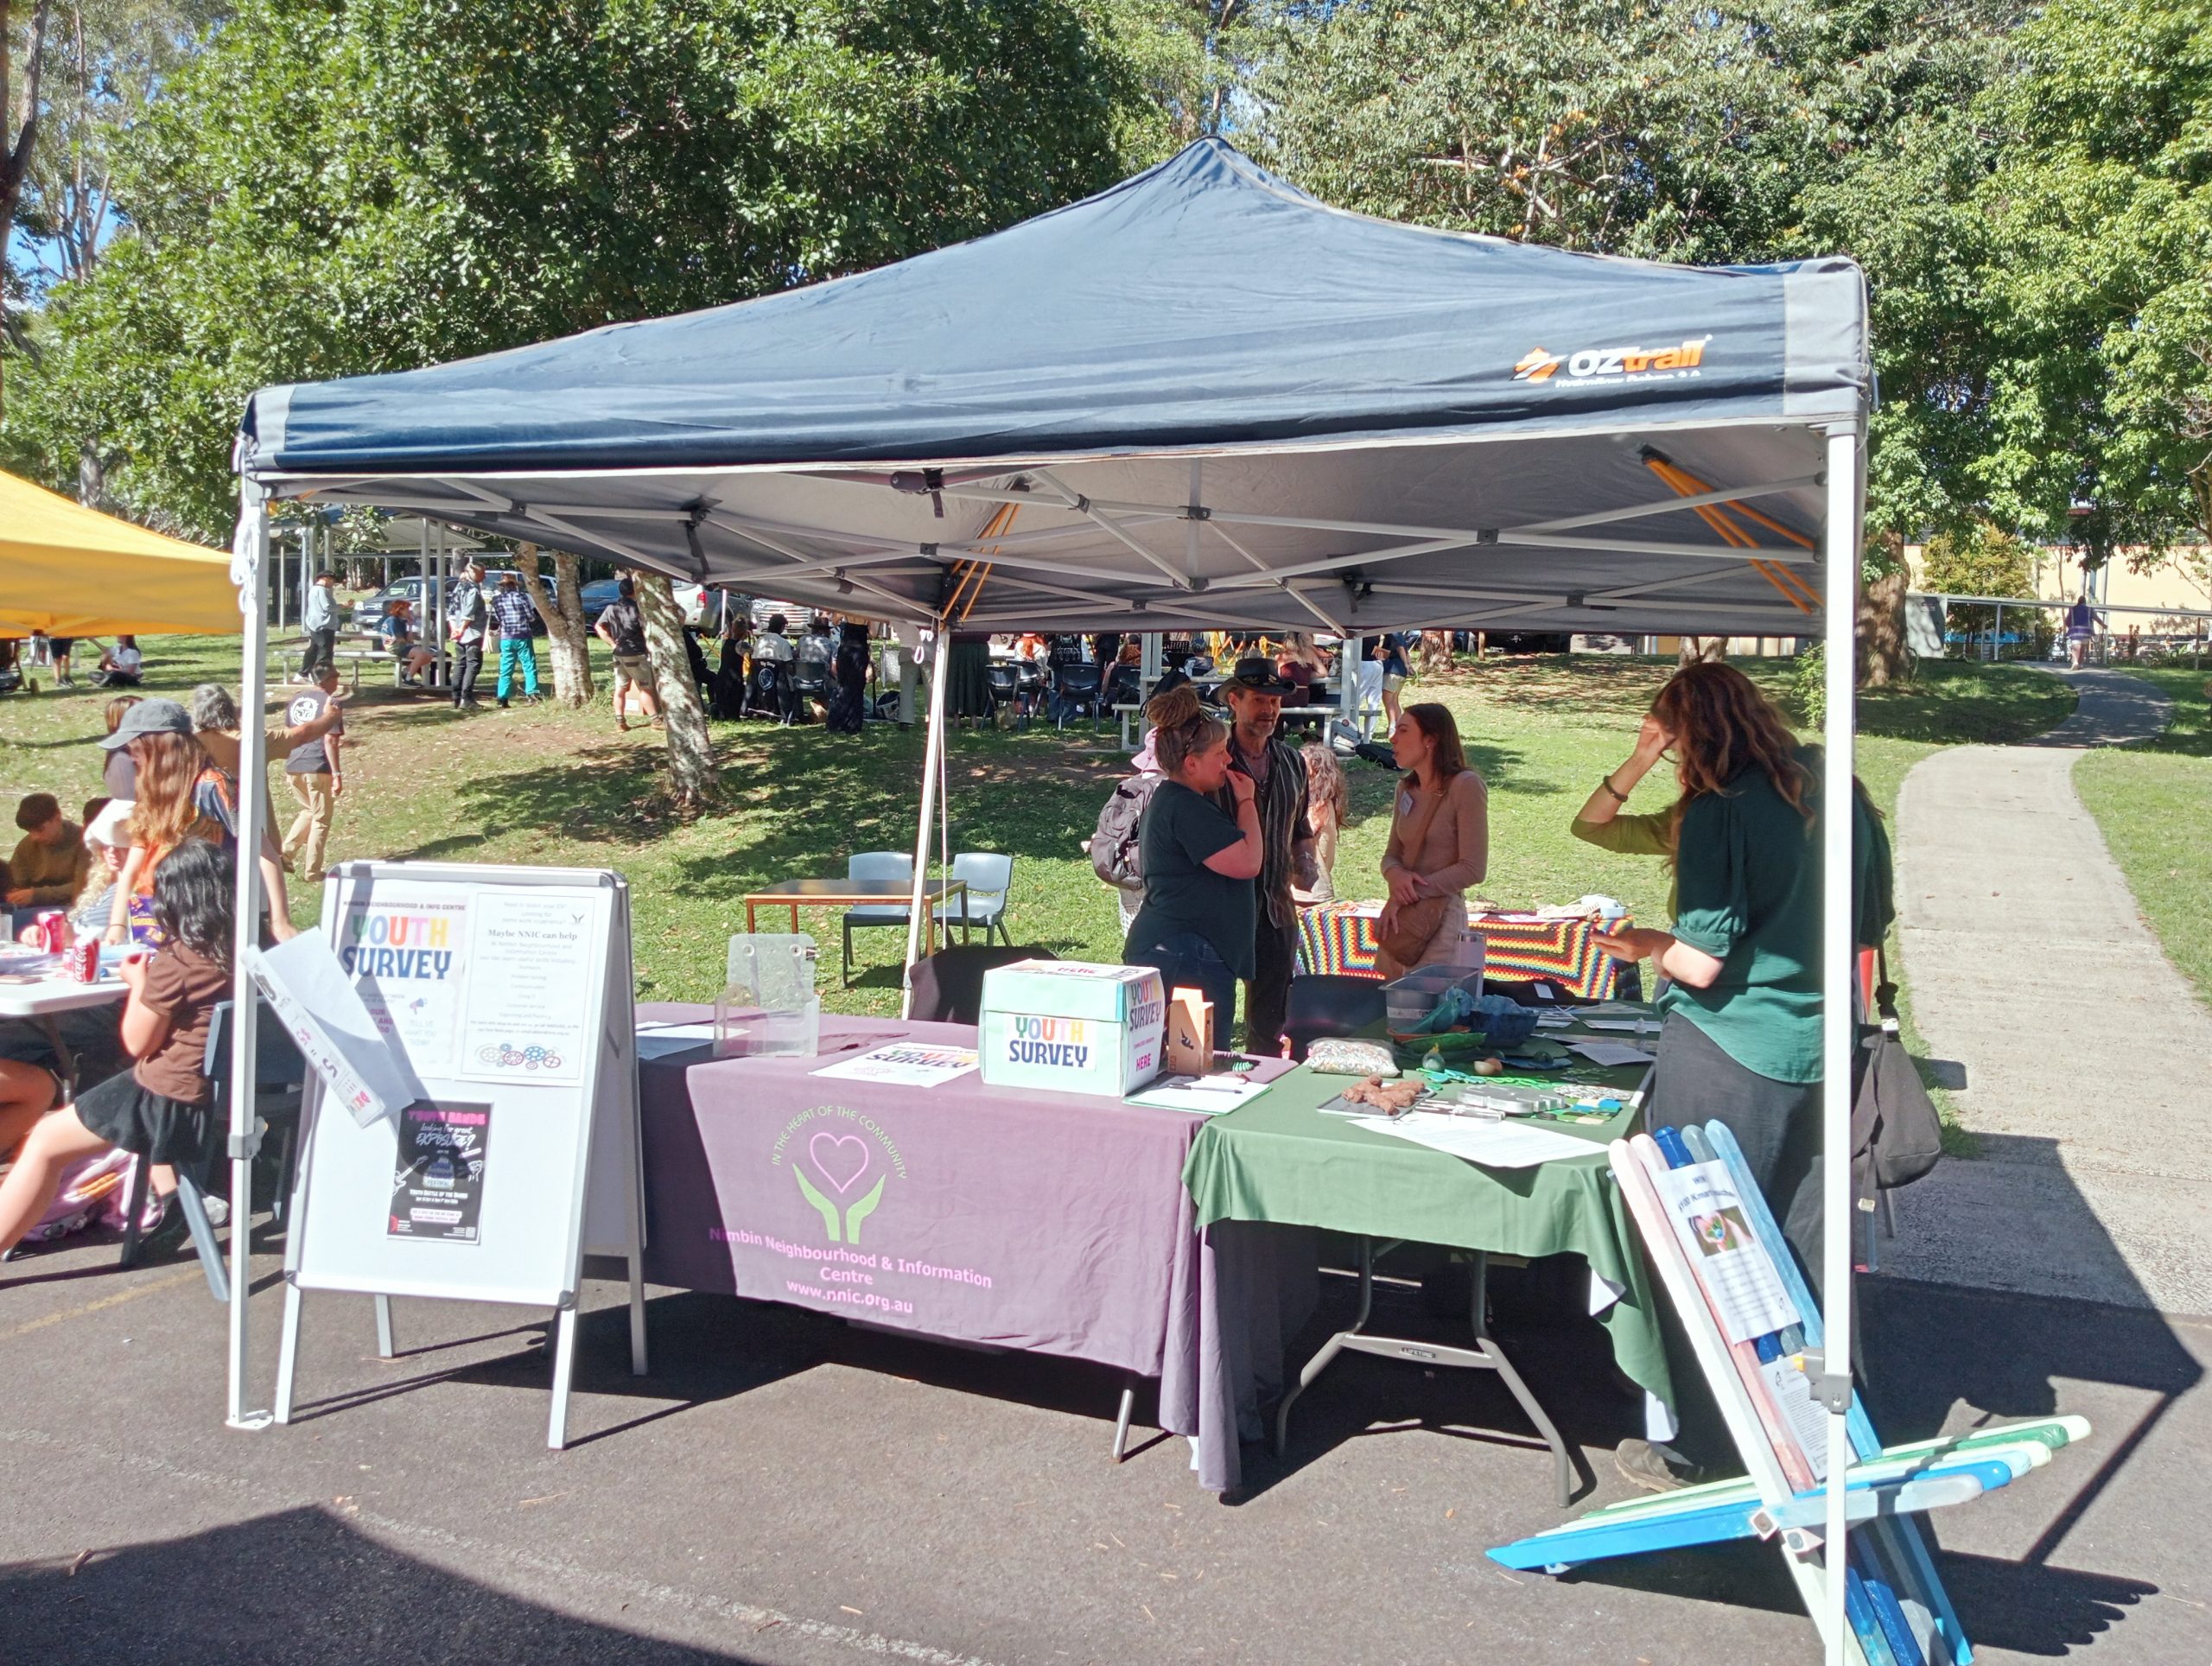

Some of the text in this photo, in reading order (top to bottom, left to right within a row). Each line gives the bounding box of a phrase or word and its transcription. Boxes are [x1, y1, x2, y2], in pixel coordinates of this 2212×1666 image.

[1568, 337, 1710, 377] OZtrail
[352, 914, 449, 947] YOUTH
[488, 929, 516, 938] Maybe
[518, 930, 542, 938] NNIC
[559, 932, 577, 941] help
[342, 945, 452, 980] SURVEY
[1131, 978, 1160, 1005] YOUTH
[1015, 1016, 1084, 1043] YOUTH
[1130, 1001, 1161, 1032] SURVEY
[866, 1053, 969, 1068] SURVEY
[1009, 1040, 1088, 1068] SURVEY
[1136, 1053, 1152, 1071] HERE
[772, 1105, 908, 1180] IN THE HEART OF THE COMMUNITY
[709, 1226, 993, 1289] Nimbin Neighbourhood & Information
[819, 1267, 874, 1286] Centre
[785, 1279, 913, 1313] www.nnic.org.au
